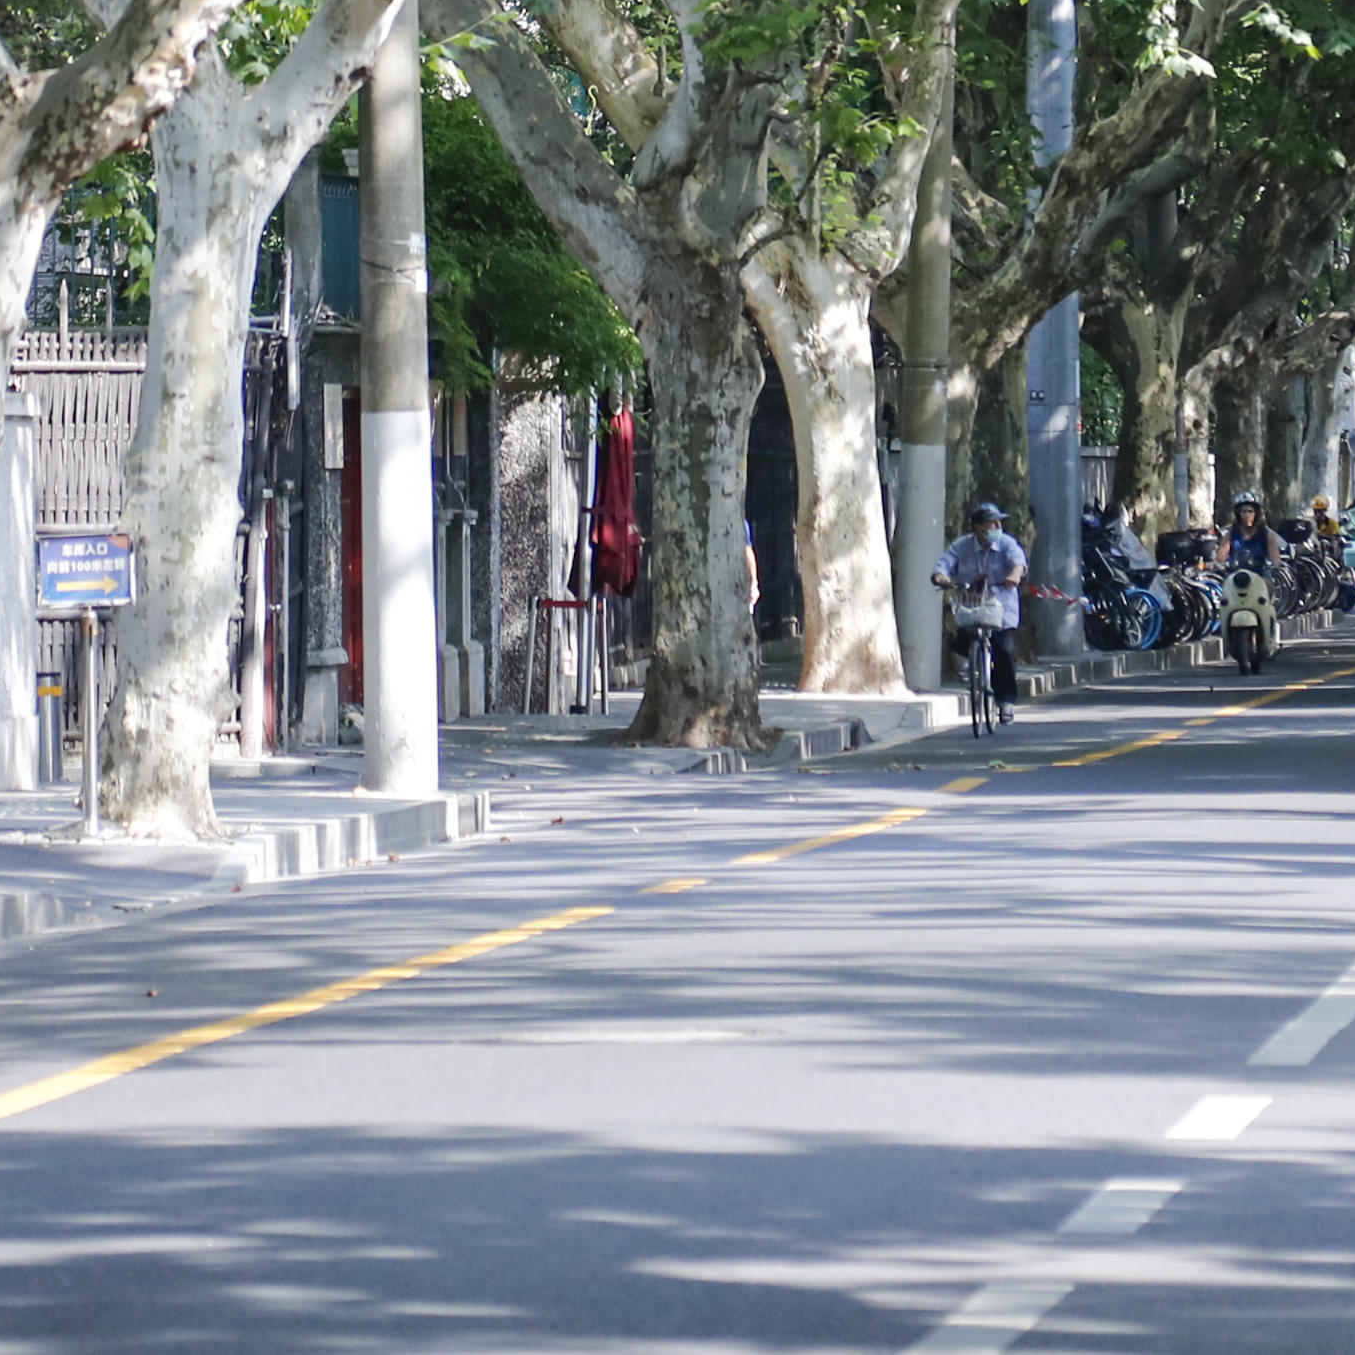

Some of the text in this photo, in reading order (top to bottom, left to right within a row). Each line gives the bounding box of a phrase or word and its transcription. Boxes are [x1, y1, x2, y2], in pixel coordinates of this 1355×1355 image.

[62, 542, 108, 557] 车库入口
[47, 557, 126, 574] 向前100米左转
